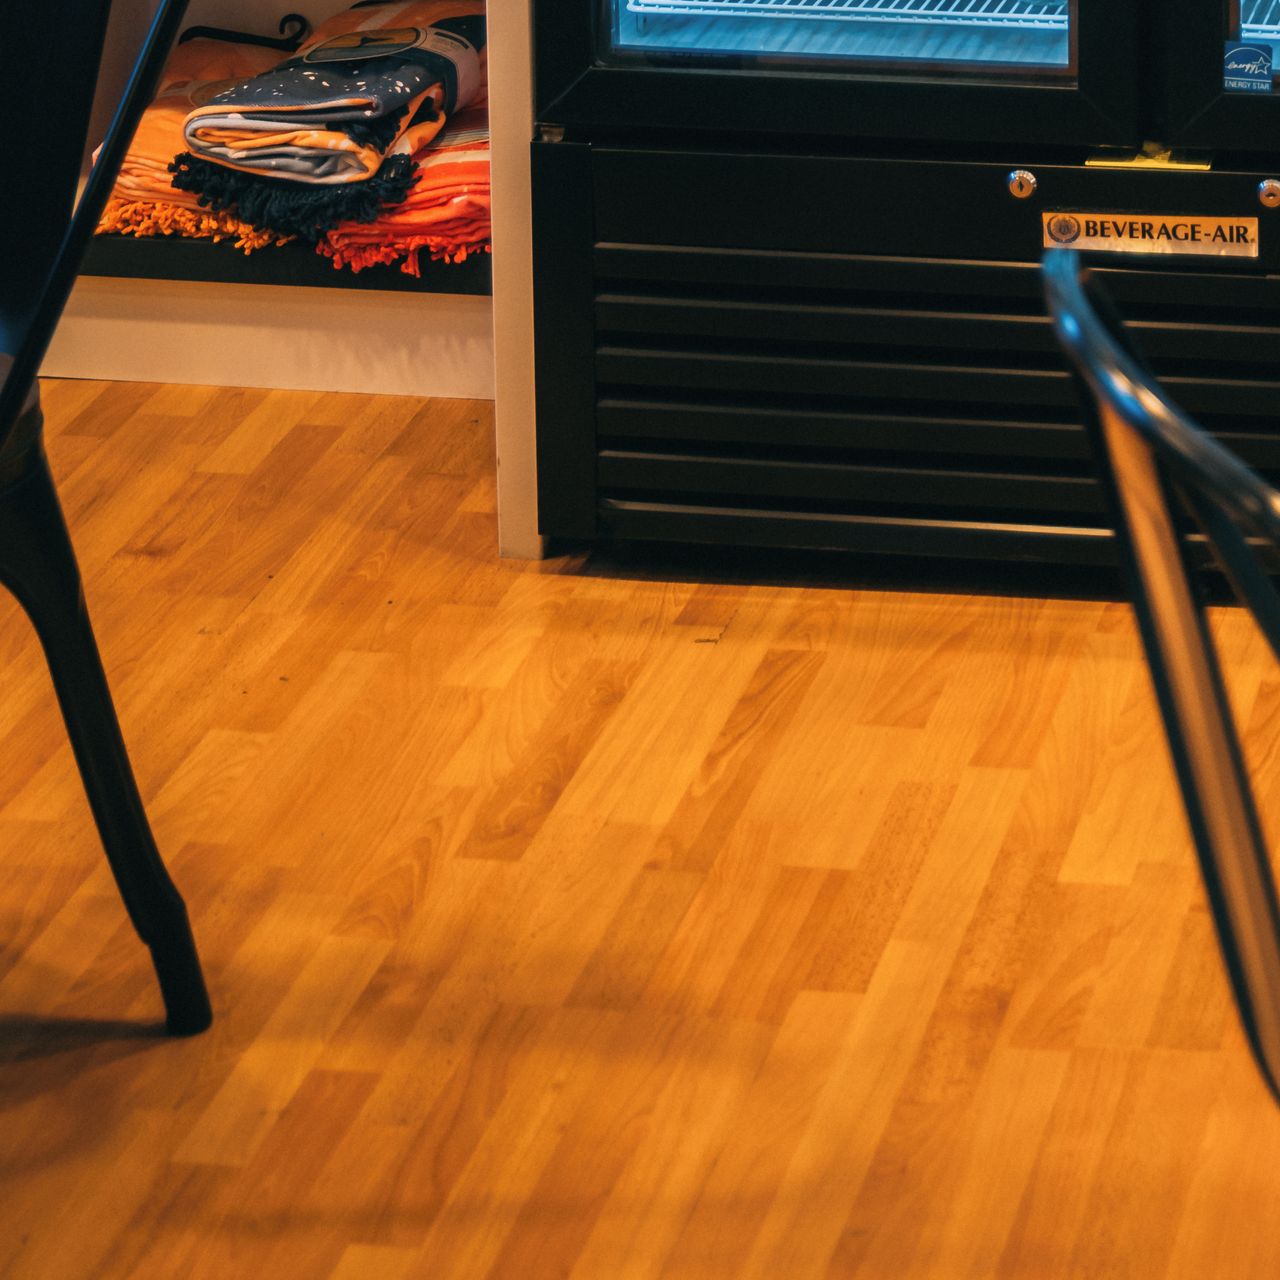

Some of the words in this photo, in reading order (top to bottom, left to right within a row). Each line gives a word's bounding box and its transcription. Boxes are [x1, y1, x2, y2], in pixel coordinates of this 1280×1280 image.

[1225, 80, 1251, 88] ENERGY
[1252, 82, 1270, 90] STAR
[1085, 221, 1249, 244] BEVERAGE-AIR
